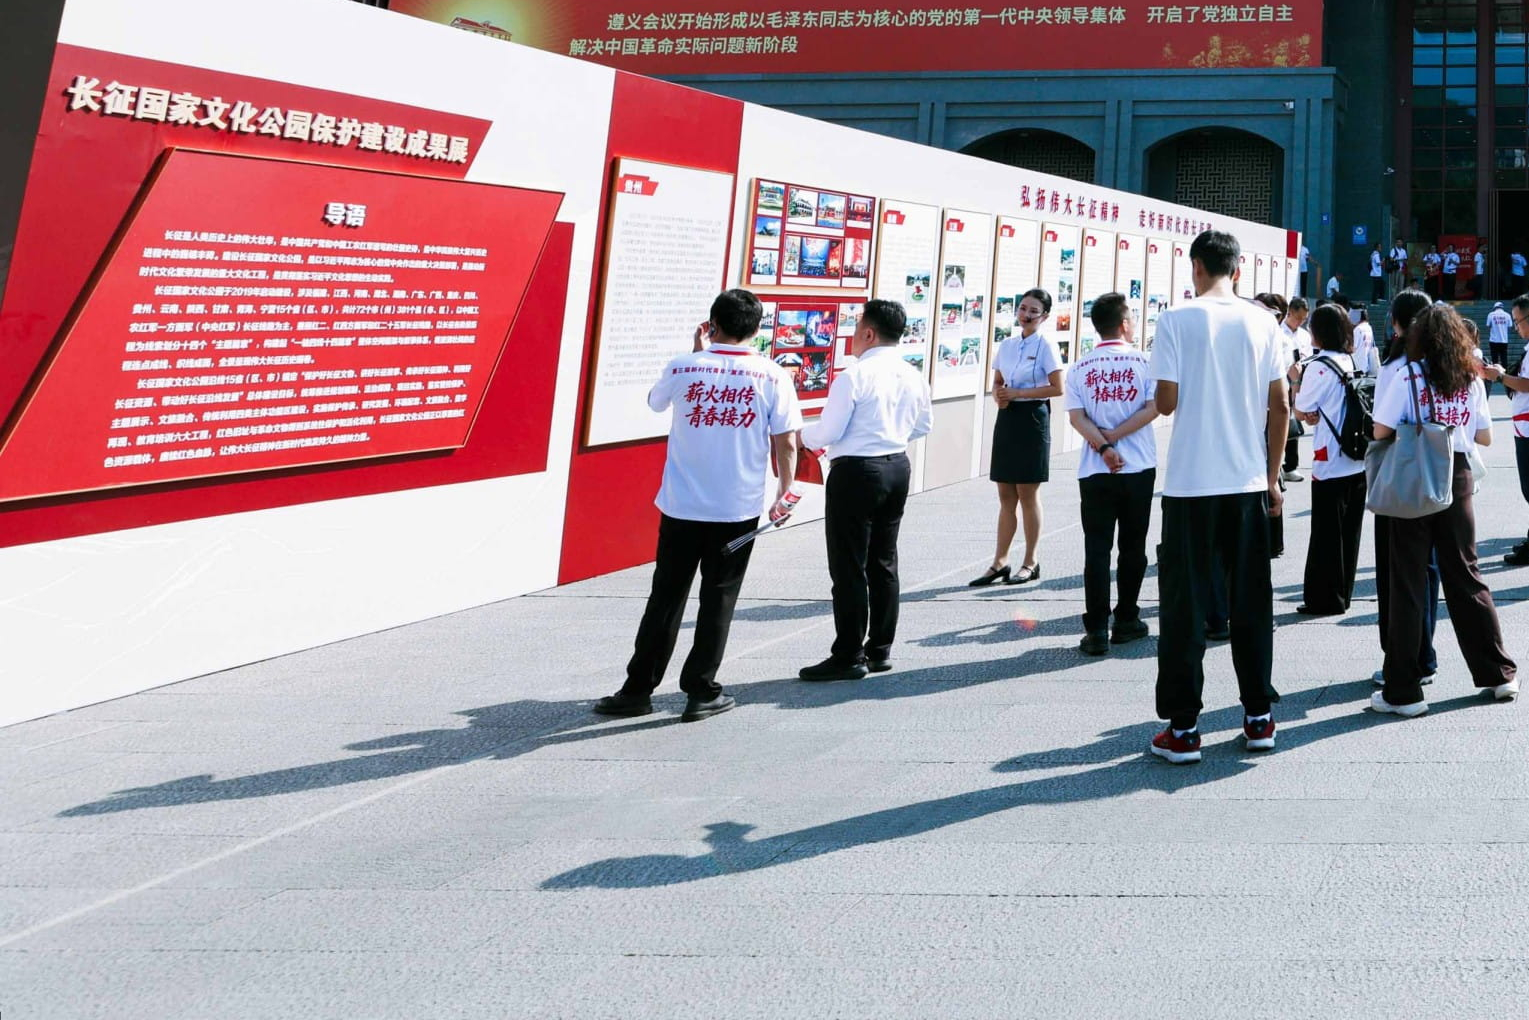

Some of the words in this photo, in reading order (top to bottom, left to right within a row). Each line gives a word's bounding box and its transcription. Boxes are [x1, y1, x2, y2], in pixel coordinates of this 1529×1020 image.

[607, 6, 1126, 31] 遵义会议开始形成以毛泽东同志为核心的党的第一代中央领导集体
[1147, 4, 1293, 23] 开启了党独立自主
[569, 35, 799, 57] 解决中国革命实际问题新阶段
[67, 75, 470, 164] 长征国家文化公园保护建设成果展
[322, 202, 367, 227] 导语
[1021, 185, 1119, 222] 弘扬伟大长征精神
[1084, 367, 1136, 388] 薪火相传
[684, 380, 756, 406] 薪火相传
[685, 403, 757, 429] 青春接力
